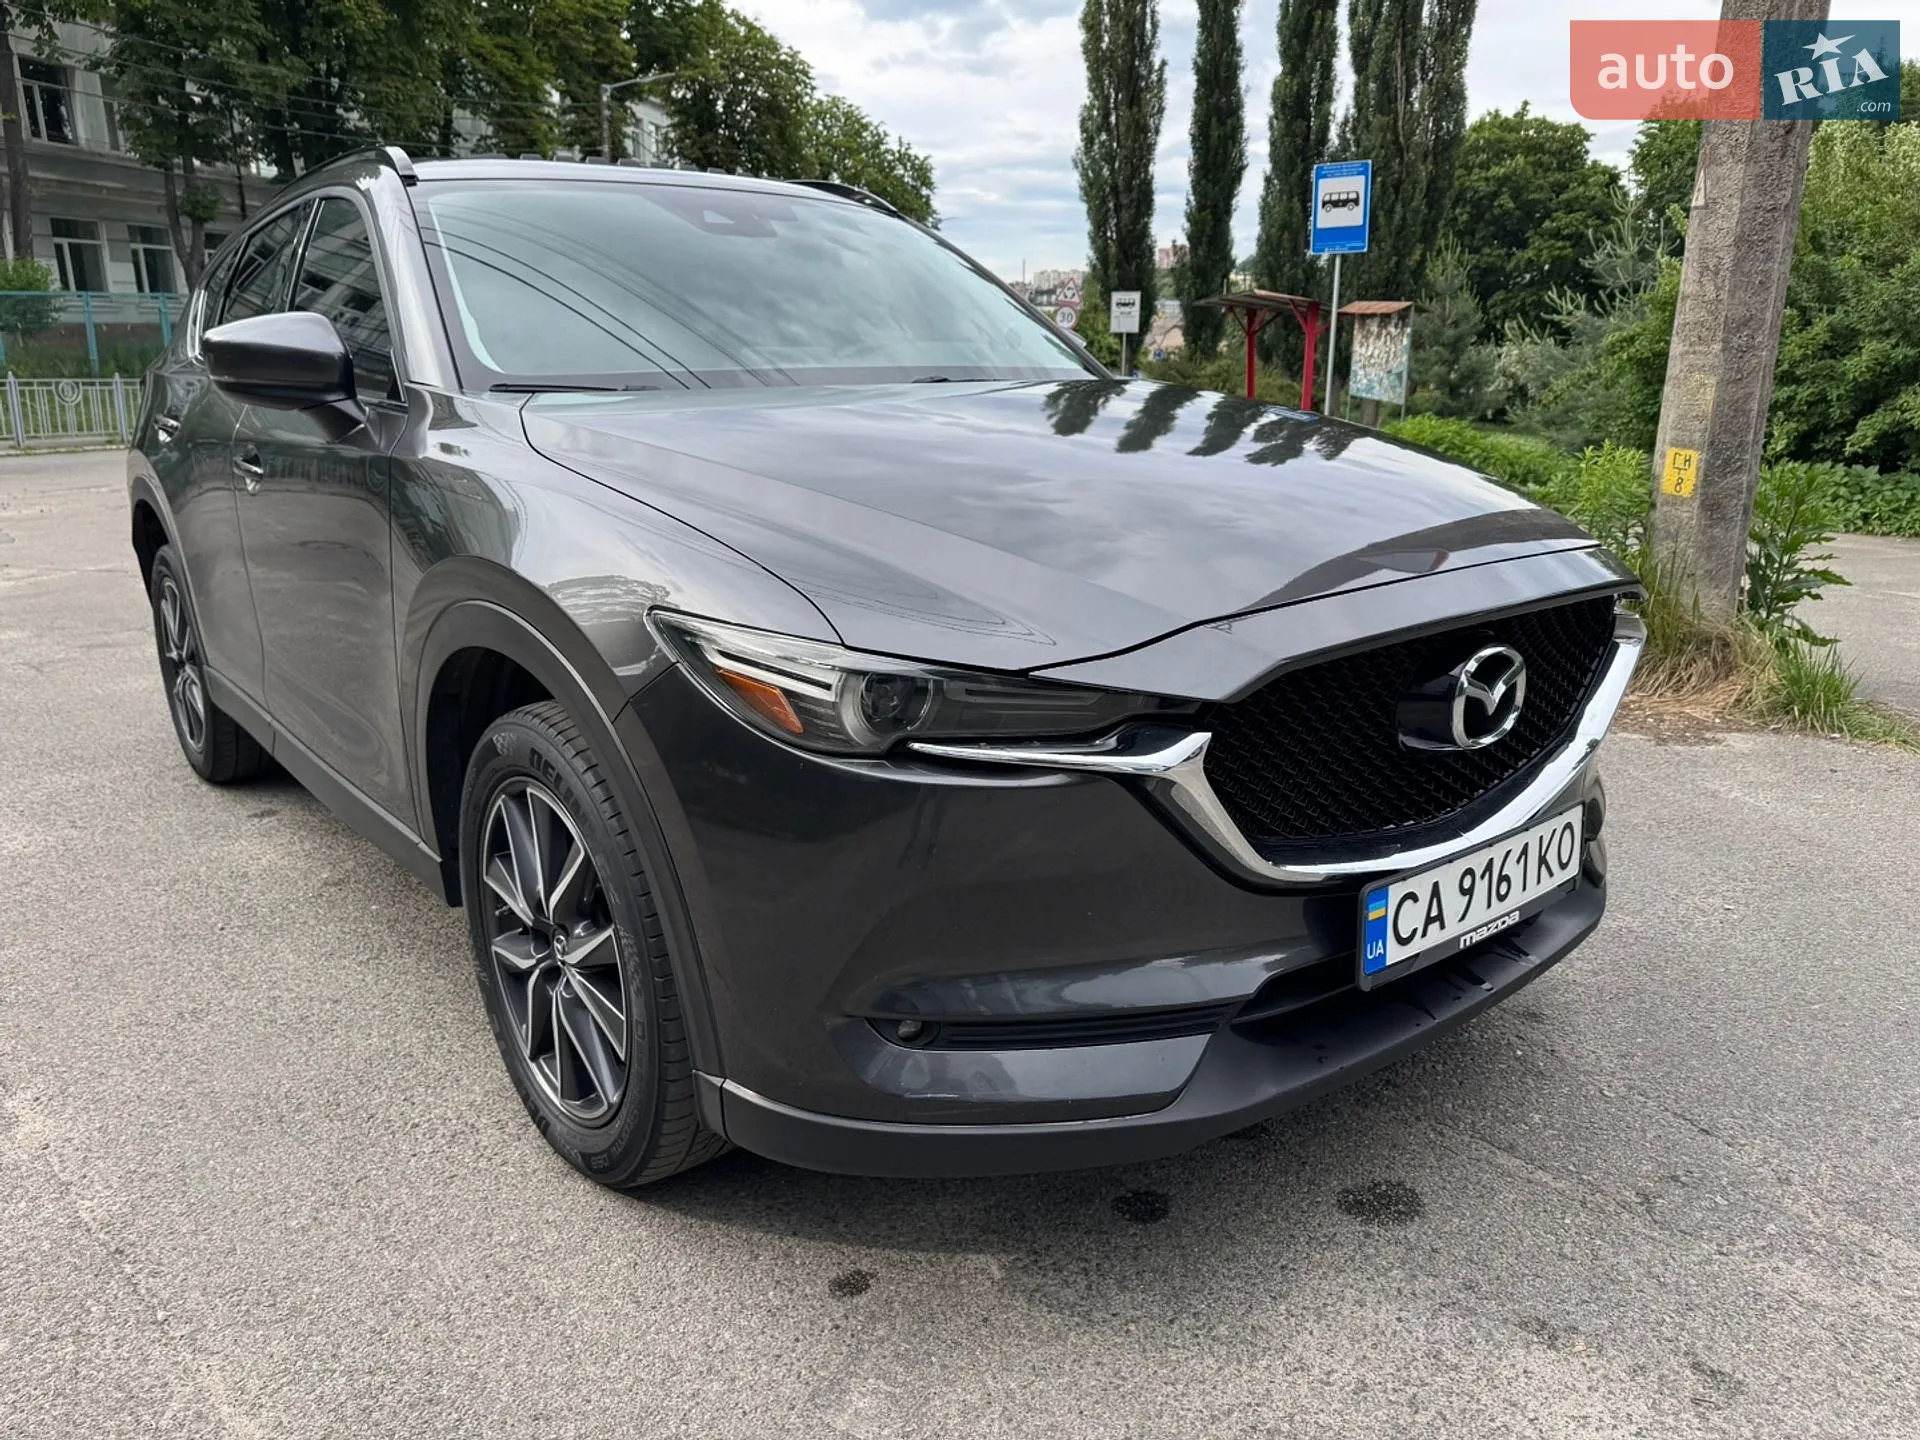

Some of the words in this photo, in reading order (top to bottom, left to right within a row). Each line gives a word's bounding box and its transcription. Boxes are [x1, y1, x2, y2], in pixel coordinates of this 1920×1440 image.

[1059, 311, 1073, 324] 30
[1674, 476, 1684, 493] 8
[1366, 938, 1385, 960] UA
[1392, 880, 1446, 947] CA
[1457, 841, 1529, 923] 9161
[1536, 821, 1575, 886] KO
